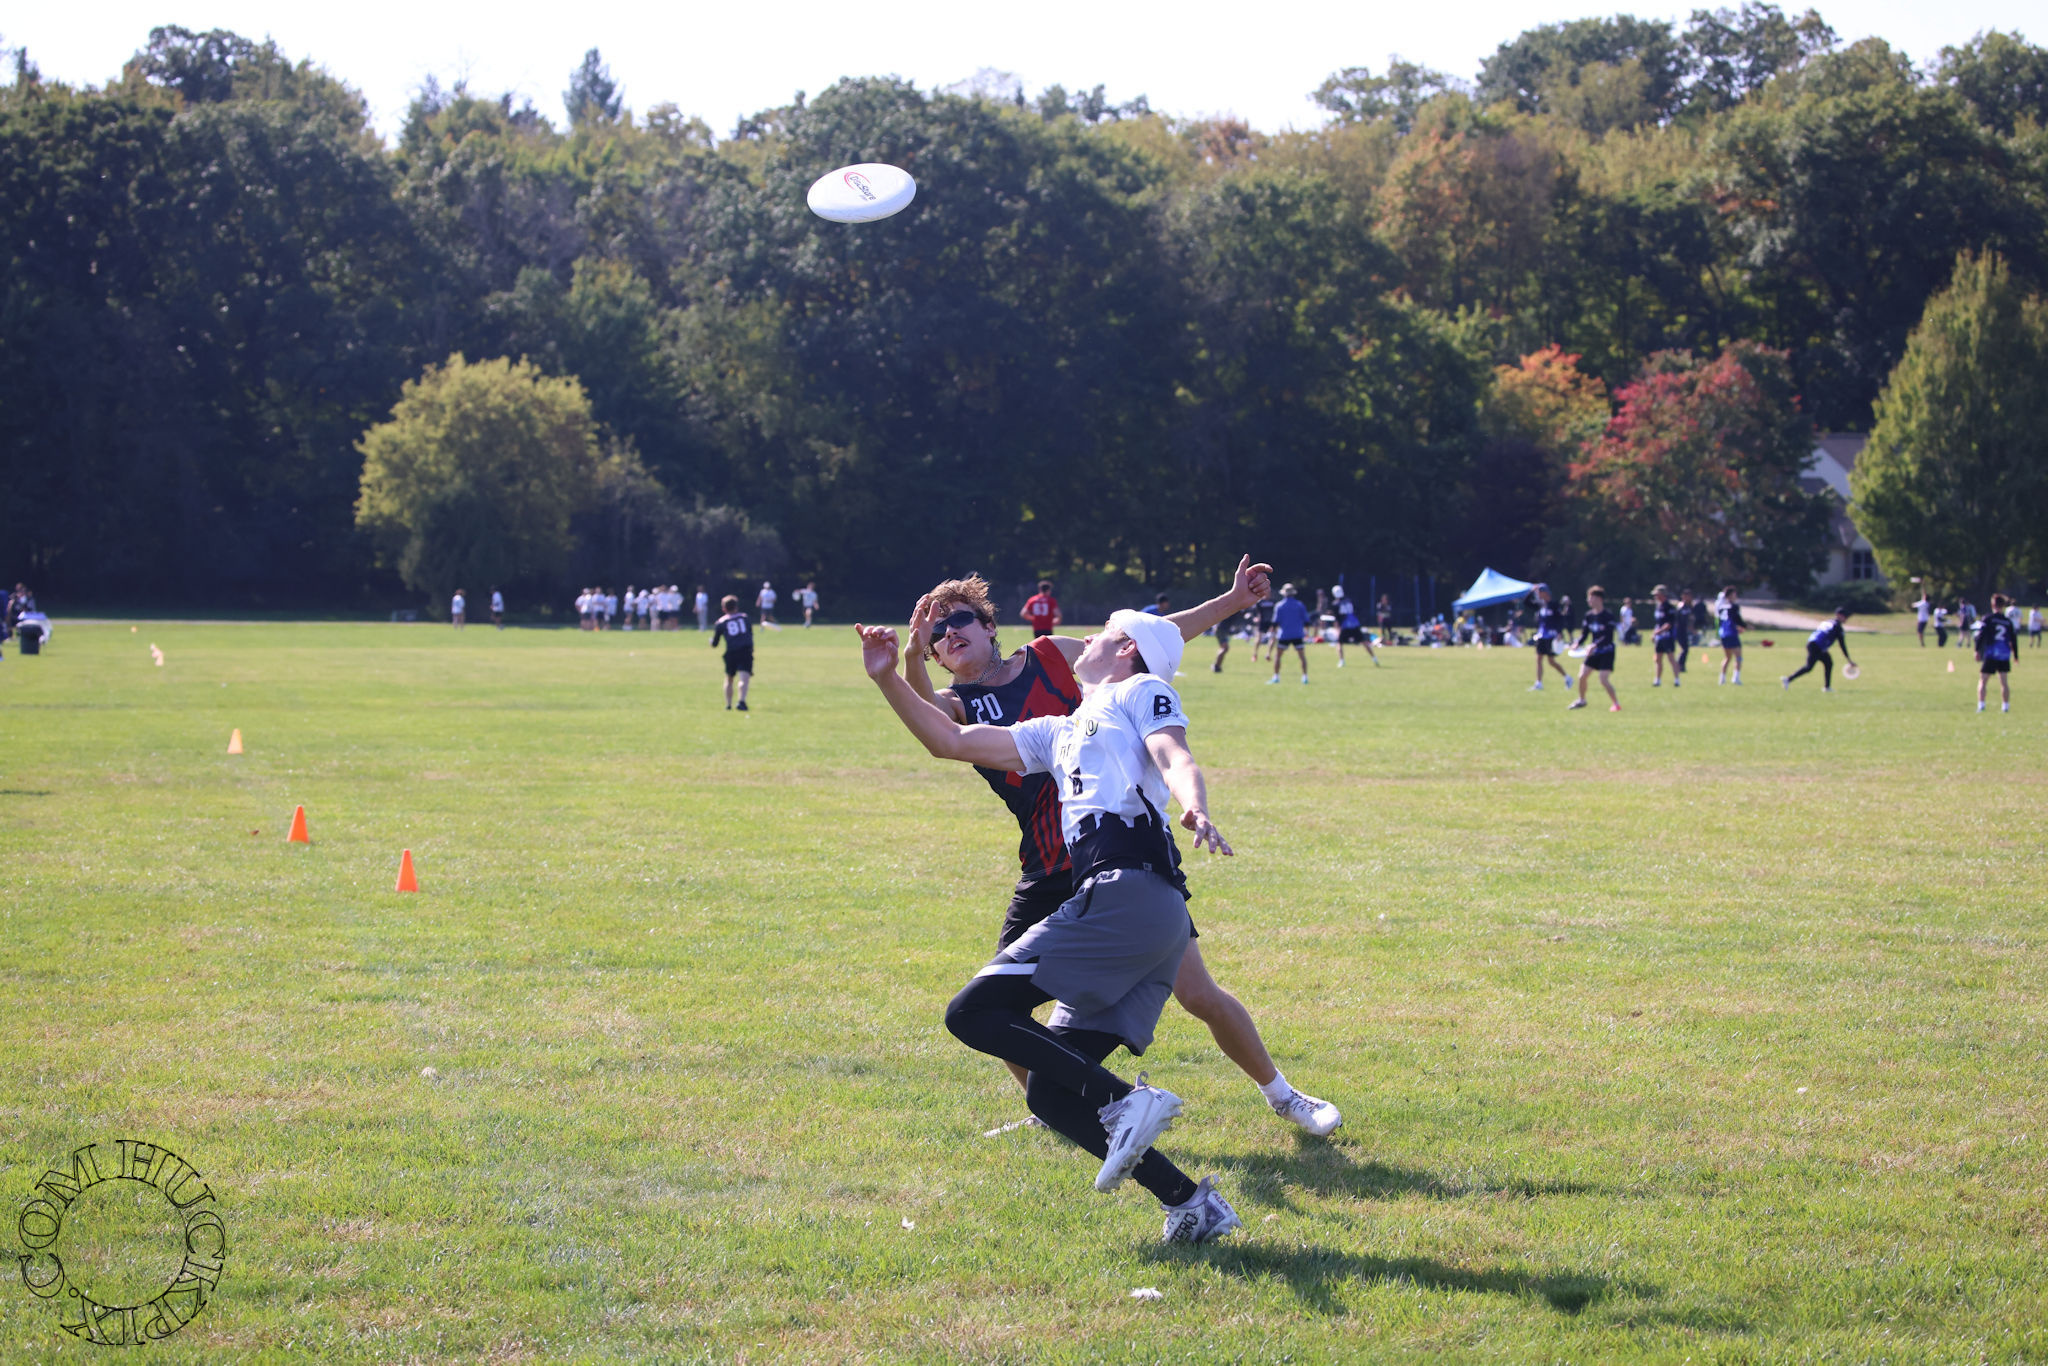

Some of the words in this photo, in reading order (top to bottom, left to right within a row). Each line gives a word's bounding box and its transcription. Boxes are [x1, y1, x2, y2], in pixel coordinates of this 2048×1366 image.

[727, 611, 747, 637] 81
[1994, 624, 2007, 641] 2
[970, 692, 1004, 725] 20
